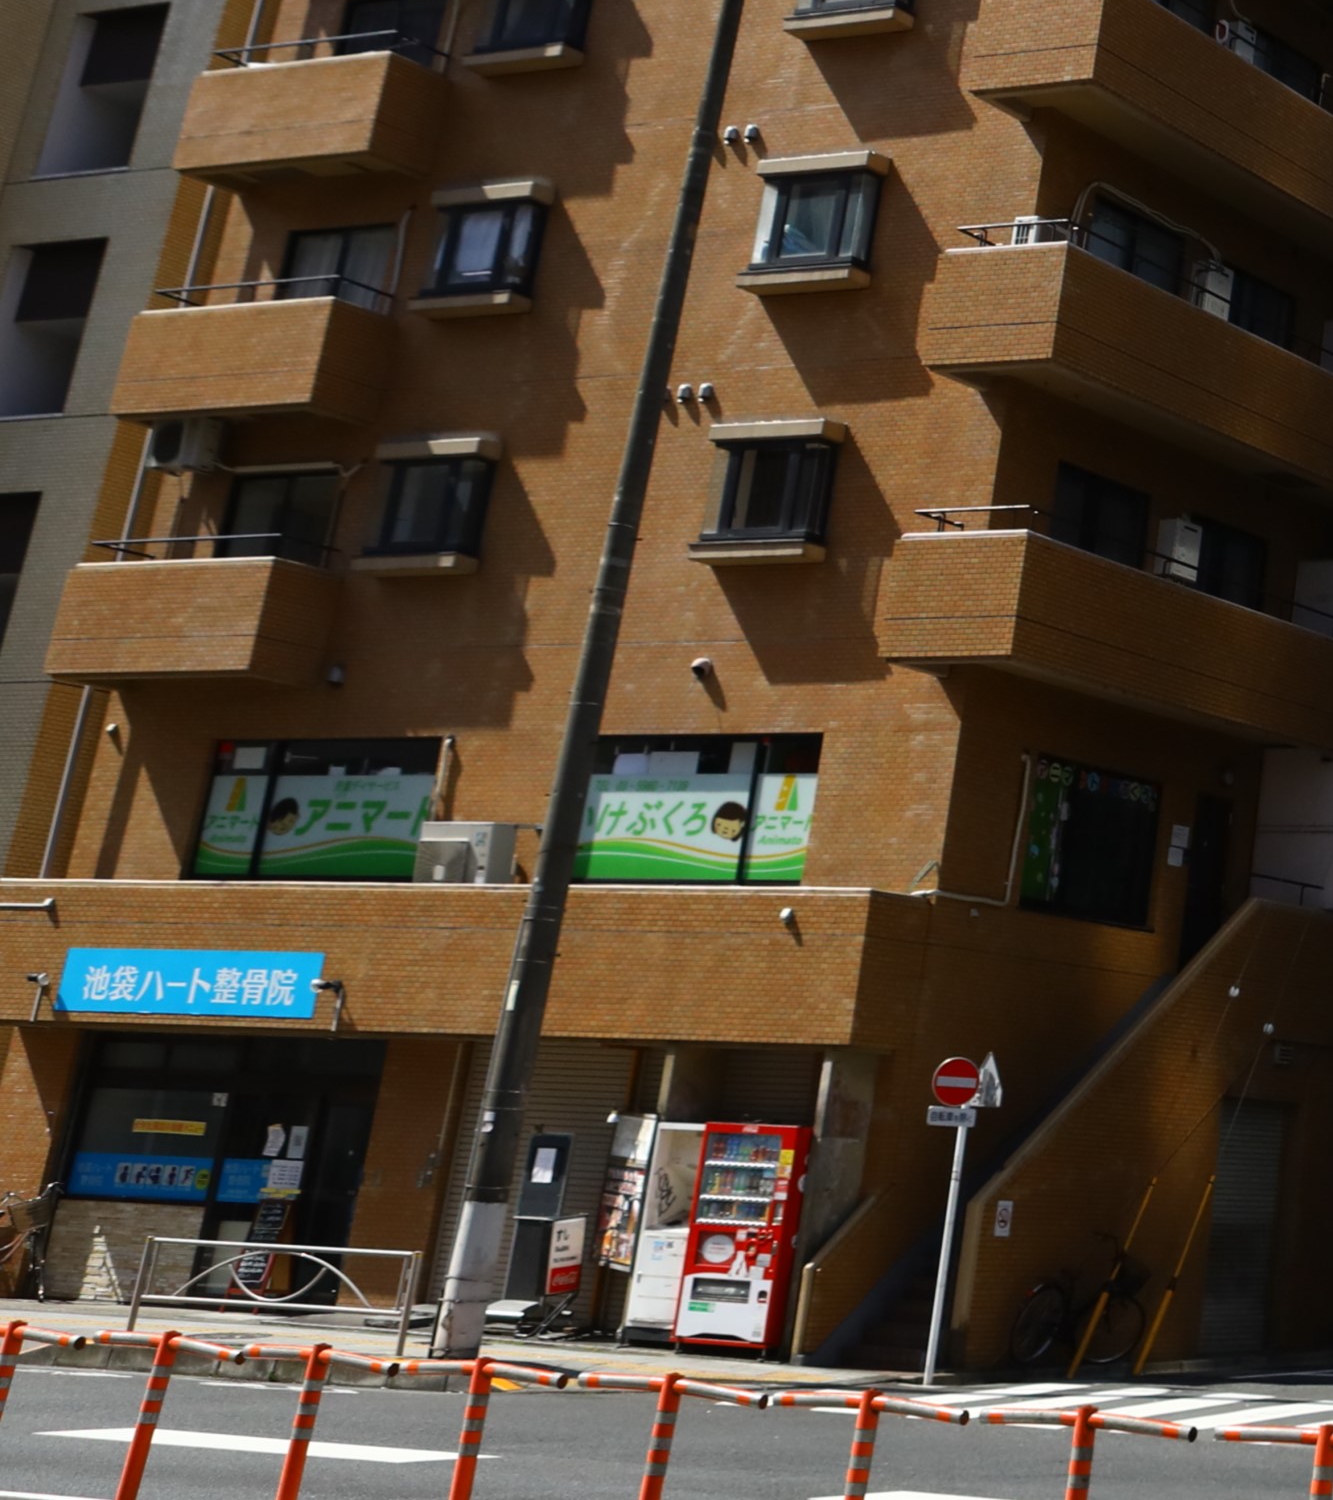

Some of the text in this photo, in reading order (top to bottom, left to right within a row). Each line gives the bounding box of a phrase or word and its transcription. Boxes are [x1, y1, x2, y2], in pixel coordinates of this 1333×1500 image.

[82, 965, 298, 1006] 池袋ハート整骨院
